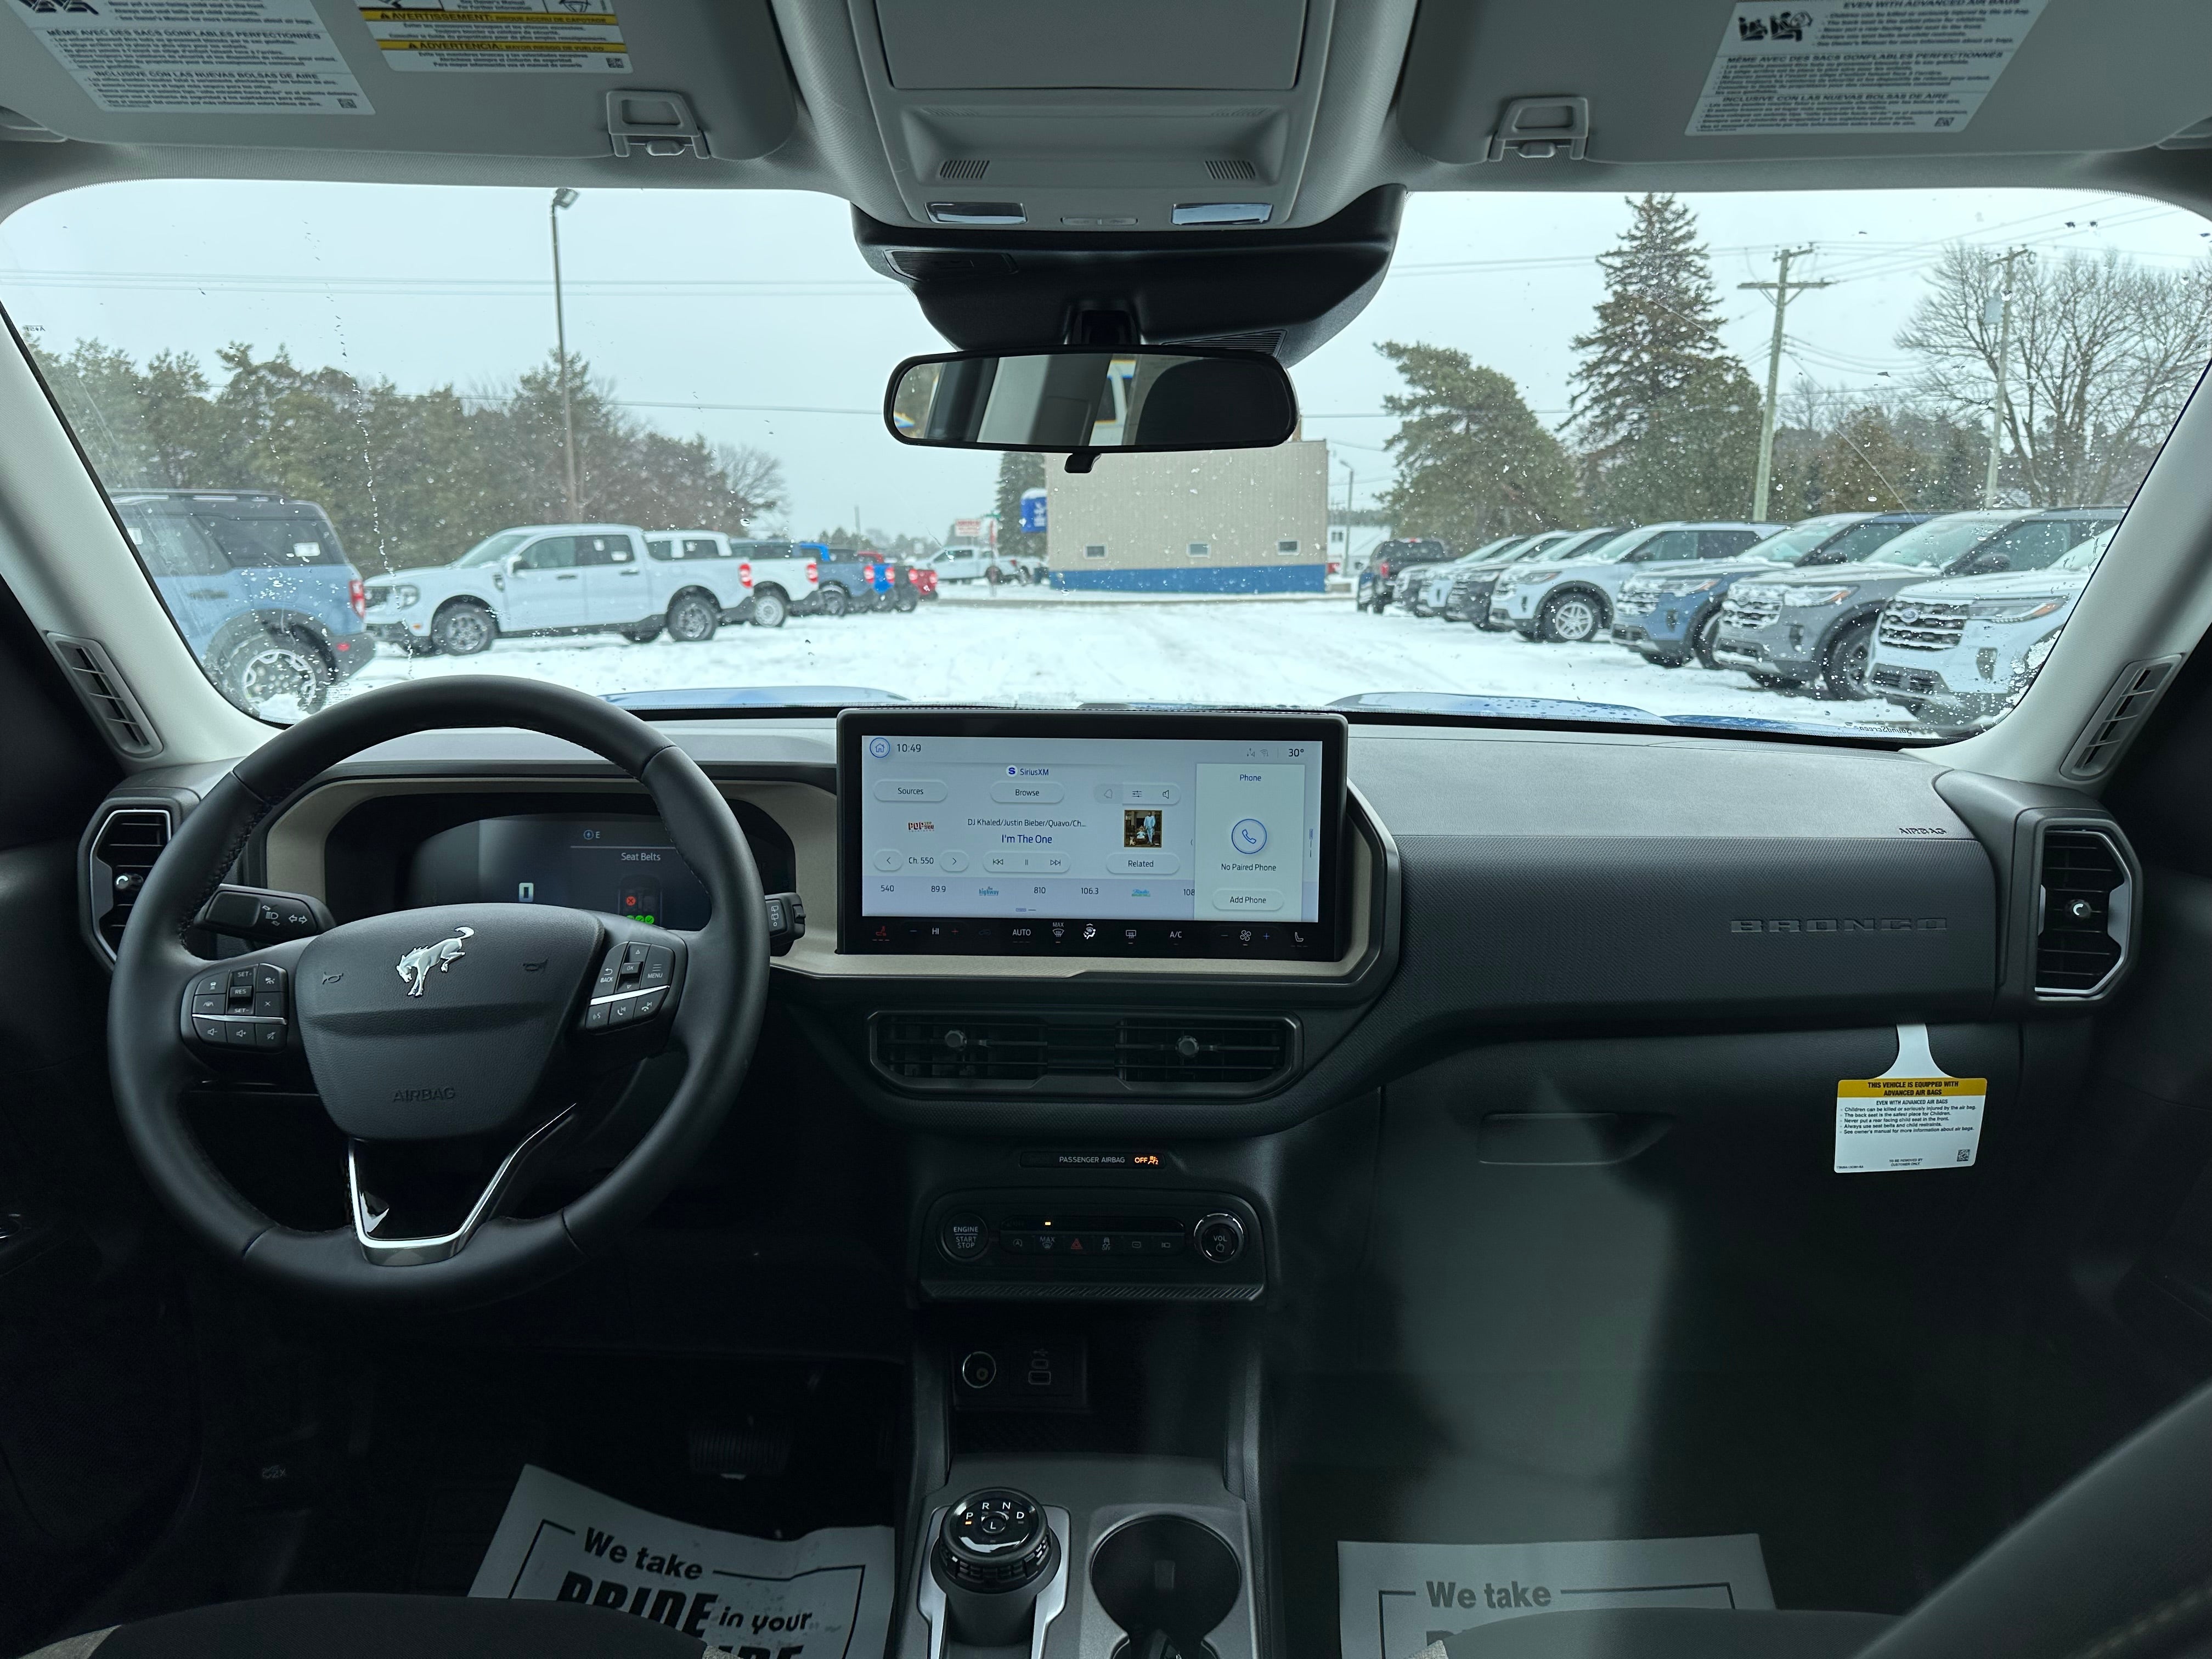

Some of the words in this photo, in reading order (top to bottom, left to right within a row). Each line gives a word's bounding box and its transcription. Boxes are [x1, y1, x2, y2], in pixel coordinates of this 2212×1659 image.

[897, 743, 922, 753] 10:49
[1002, 834, 1015, 843] I'm
[1017, 834, 1033, 843] The
[1035, 834, 1052, 844] One
[621, 853, 639, 861] Seat
[641, 853, 661, 861] Belts
[1730, 917, 1948, 933] BRONCO
[392, 1087, 455, 1102] AIRBAG
[584, 1527, 628, 1563] We
[636, 1547, 703, 1581] take
[1426, 1581, 1476, 1608] We
[1483, 1581, 1552, 1608] take
[719, 1606, 744, 1629] in
[752, 1610, 813, 1634] your
